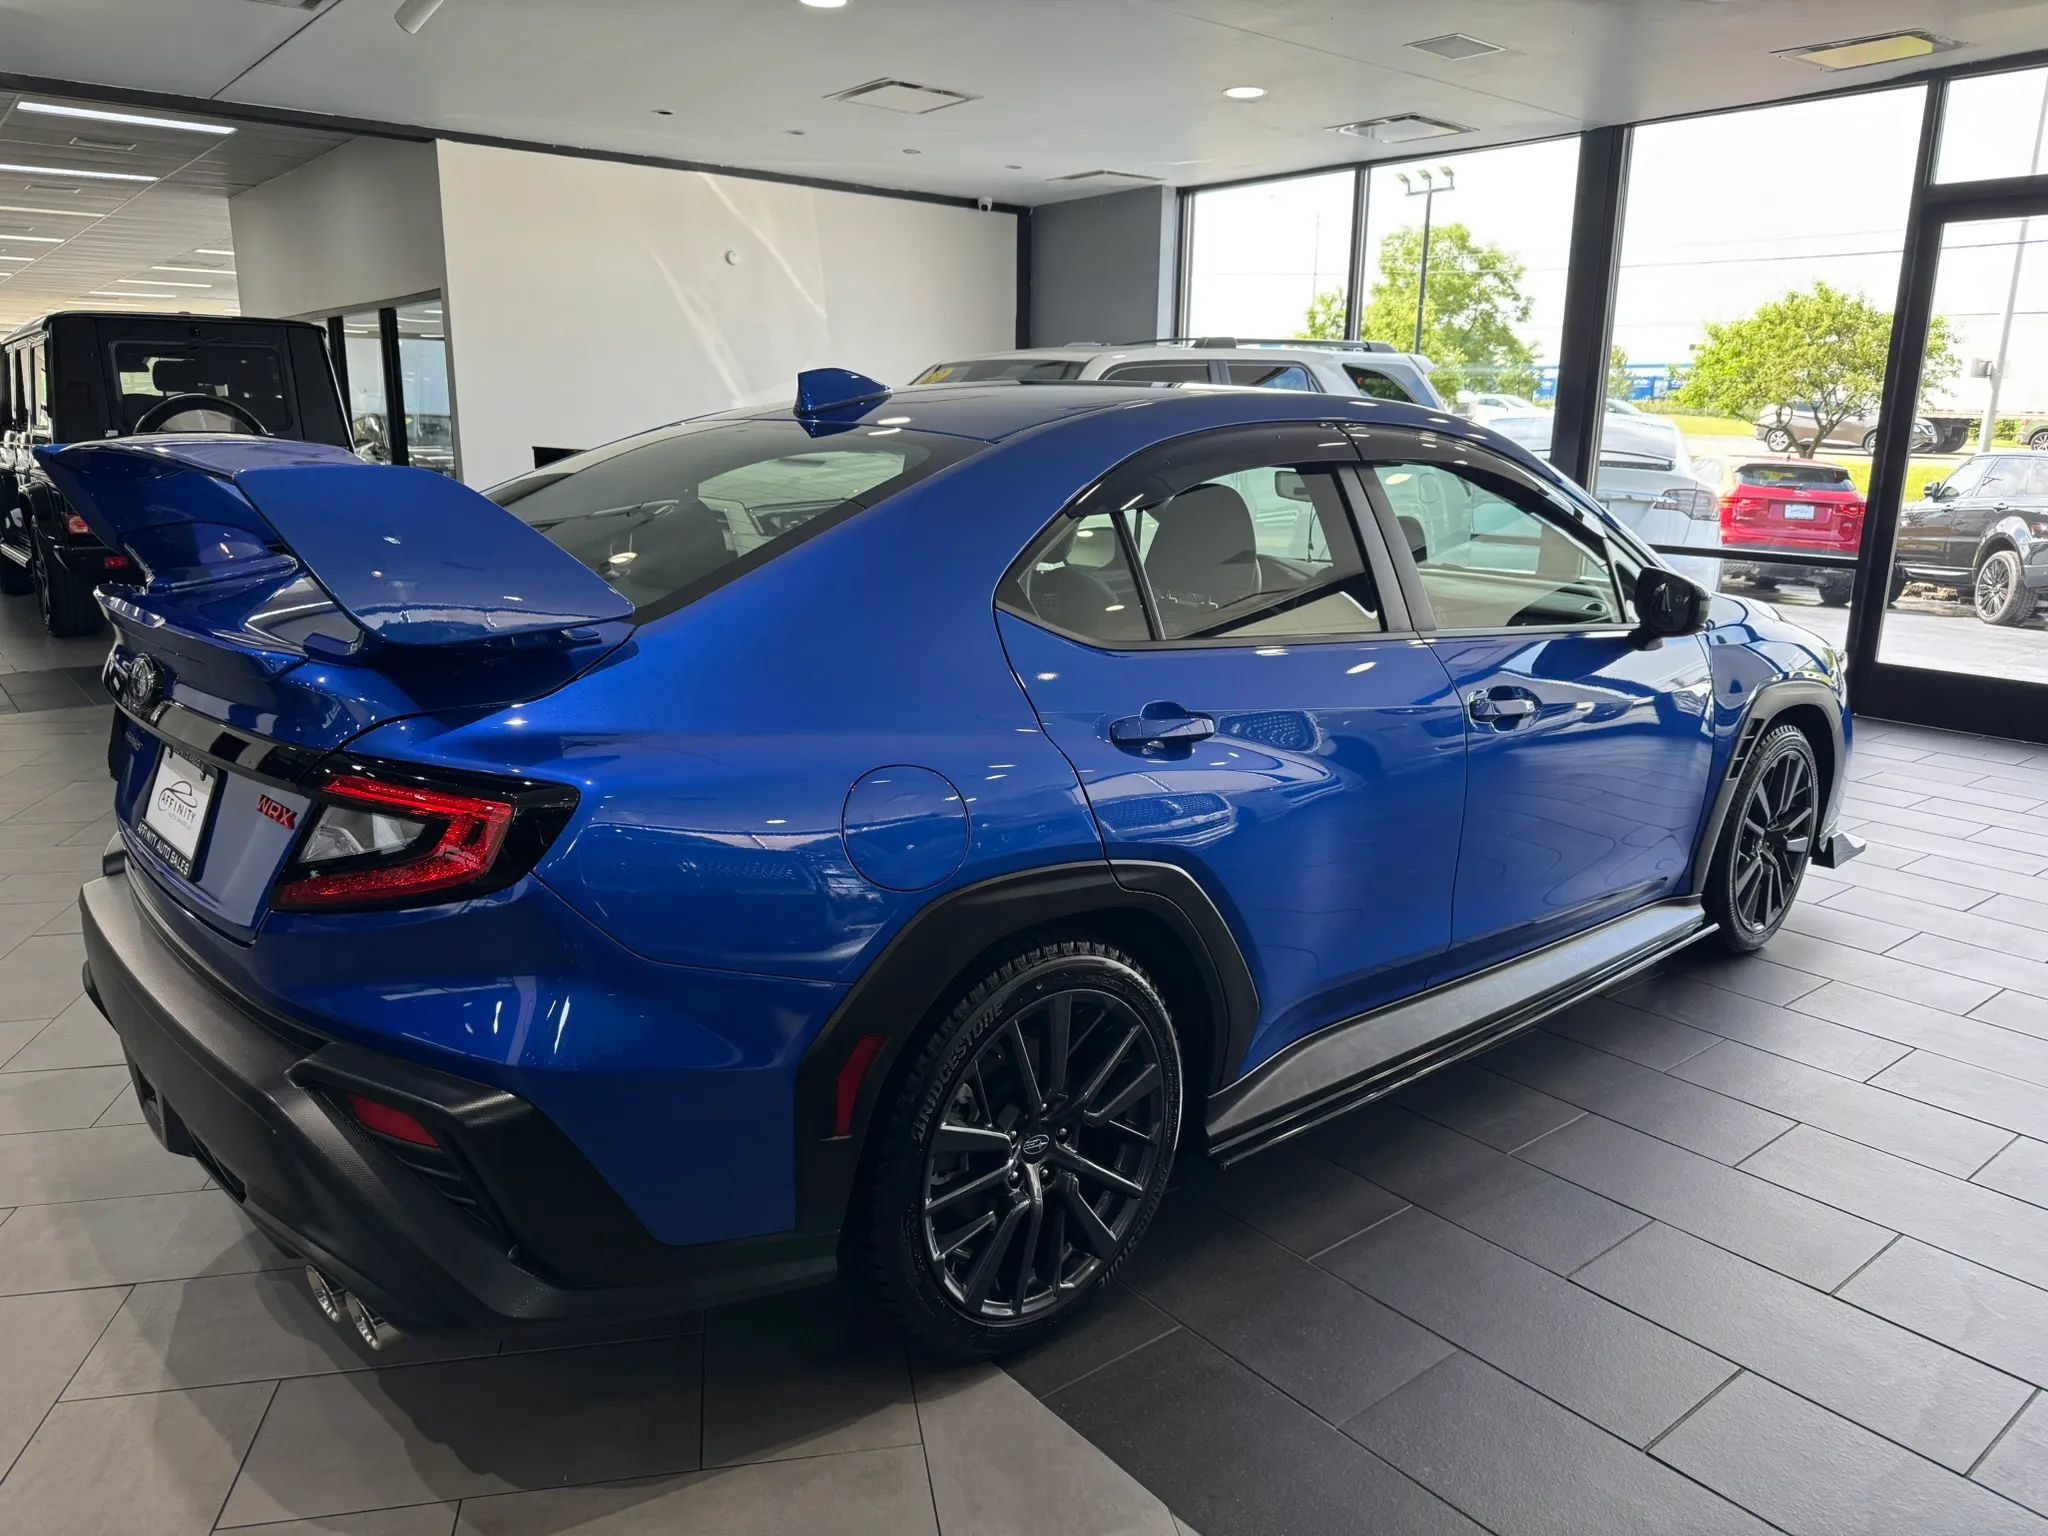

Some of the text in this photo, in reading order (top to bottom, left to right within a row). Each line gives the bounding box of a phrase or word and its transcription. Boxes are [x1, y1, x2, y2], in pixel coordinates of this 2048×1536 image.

[256, 794, 297, 830] WRX
[155, 839, 171, 860] AUTO
[169, 851, 190, 876] SALES
